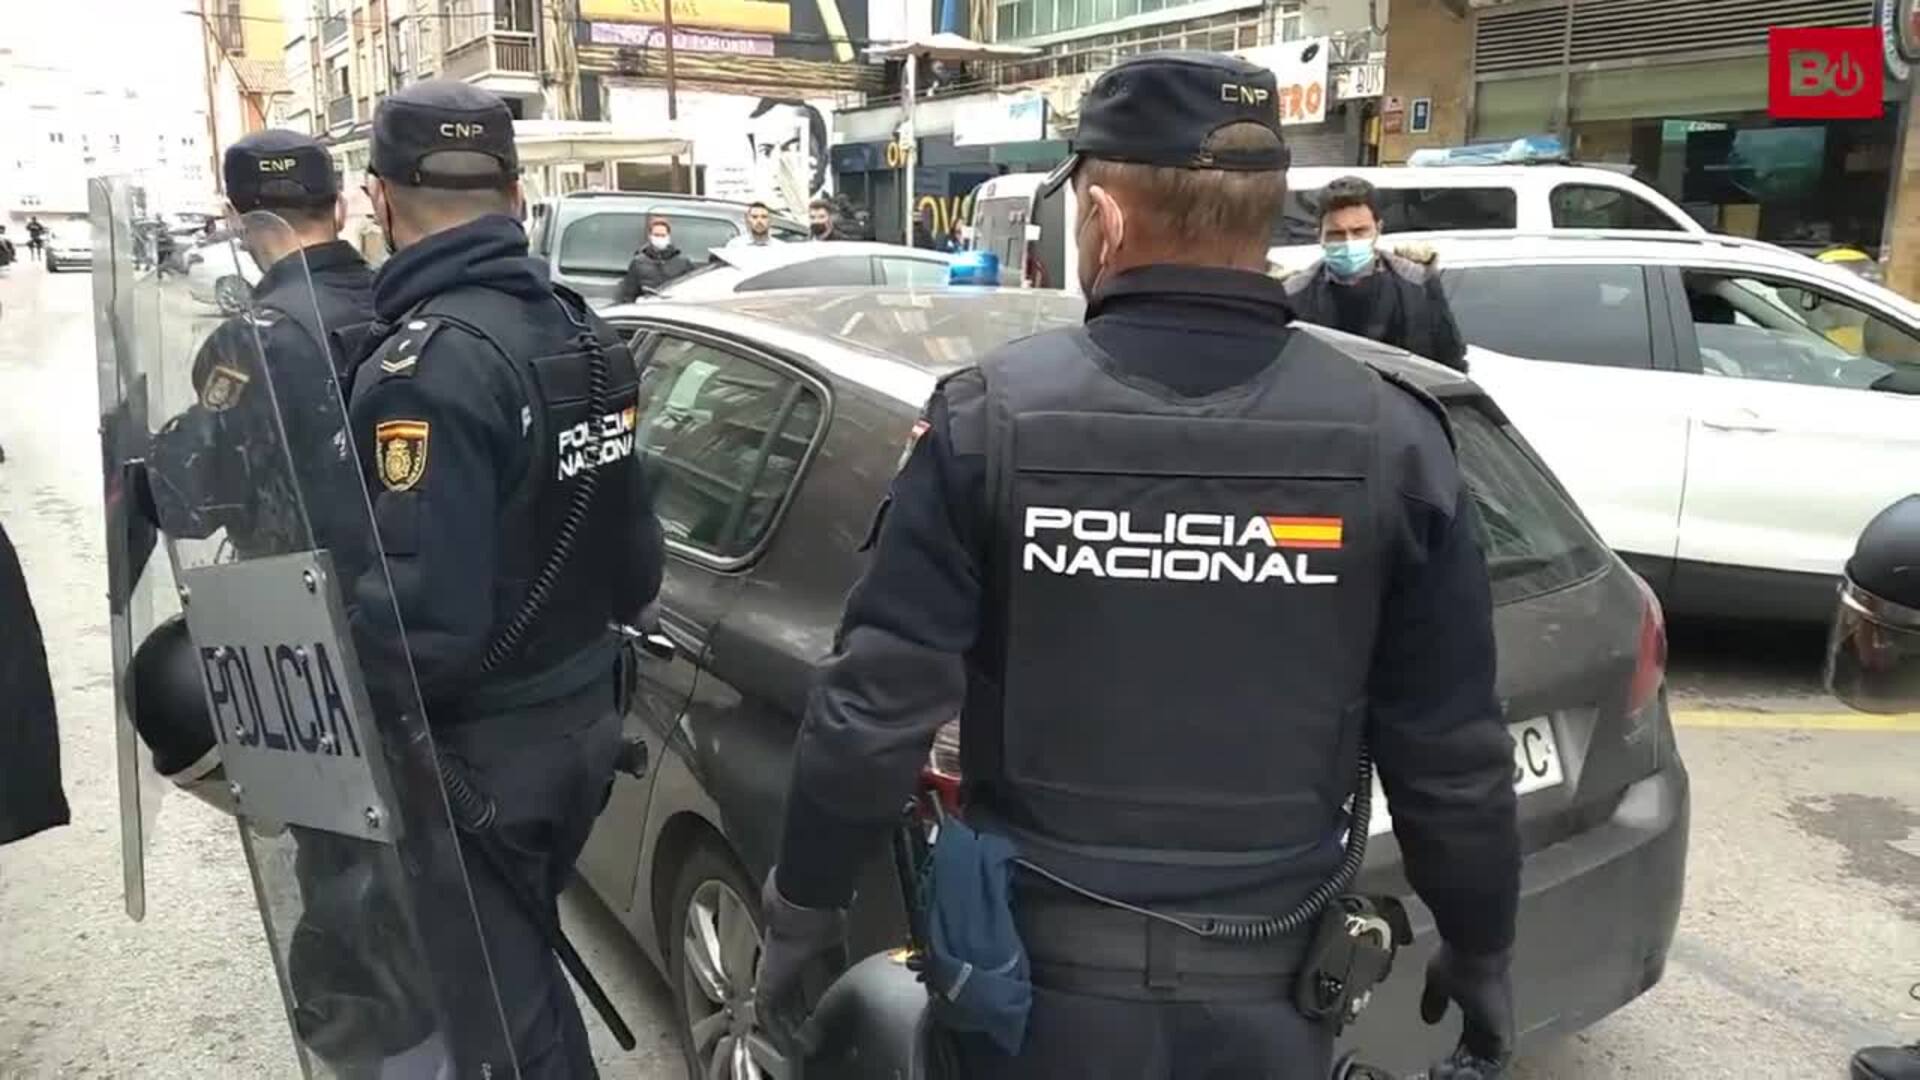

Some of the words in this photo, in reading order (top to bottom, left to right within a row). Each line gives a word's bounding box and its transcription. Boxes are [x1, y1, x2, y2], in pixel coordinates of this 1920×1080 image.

[1221, 83, 1269, 107] CNP
[440, 123, 484, 138] CNP
[259, 158, 297, 171] CNP
[1024, 506, 1278, 547] POLICIA
[1023, 543, 1338, 584] NACIONAL
[200, 642, 361, 757] POLICIA
[1513, 726, 1549, 783] C
